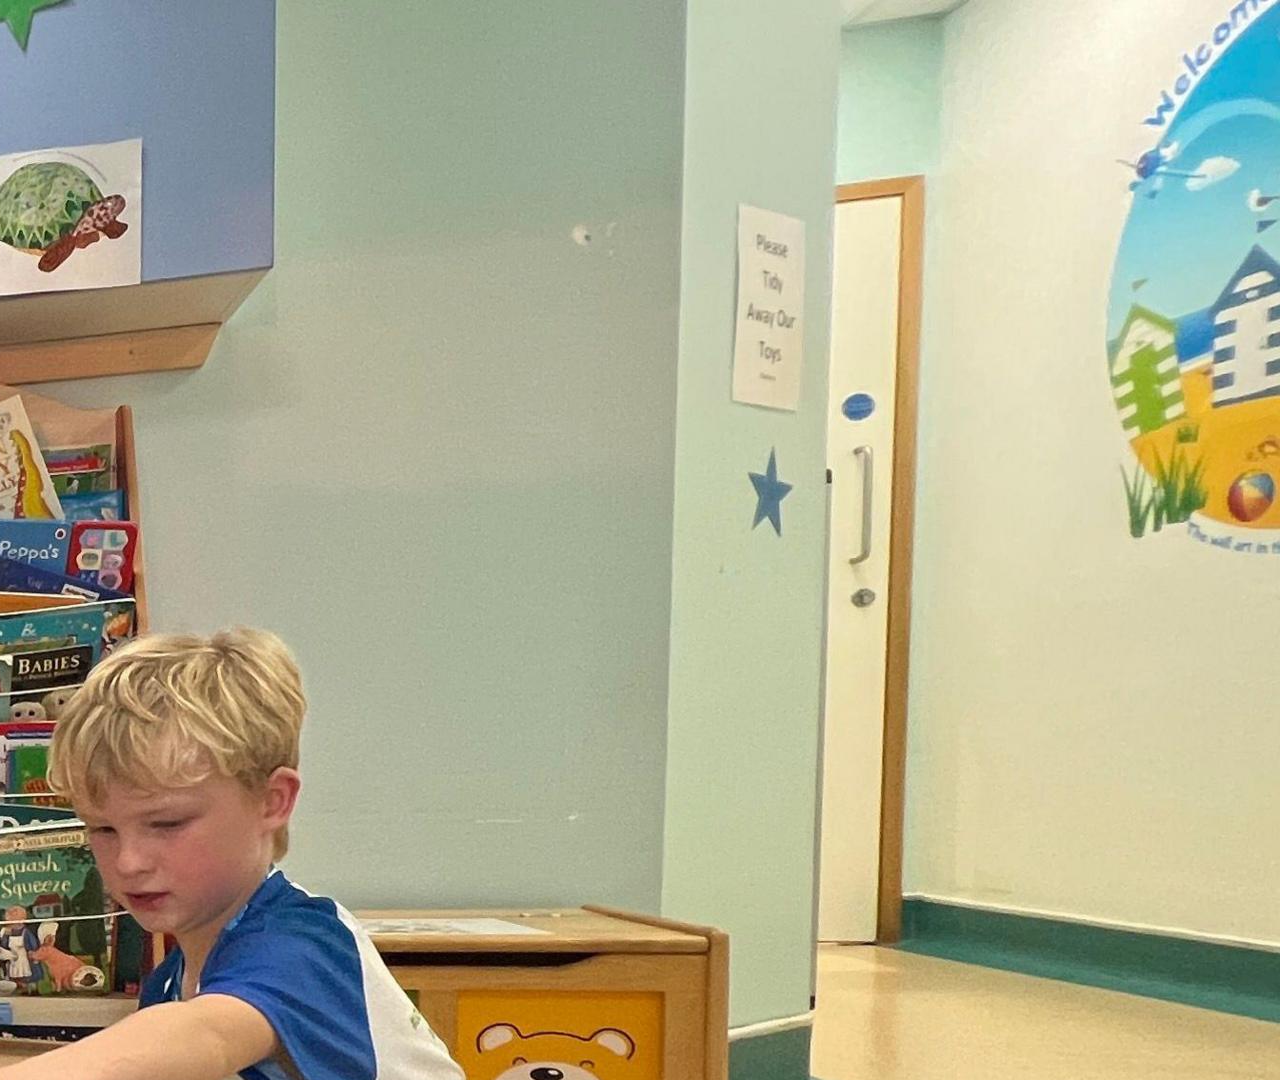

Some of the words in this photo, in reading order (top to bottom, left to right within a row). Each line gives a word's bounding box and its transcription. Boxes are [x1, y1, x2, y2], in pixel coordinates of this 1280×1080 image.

[1142, 0, 1269, 126] Welcom
[756, 233, 788, 258] Please
[762, 270, 783, 294] Tidy
[747, 303, 774, 329] Away
[777, 309, 796, 329] Our
[759, 341, 782, 365] Toys
[0, 540, 60, 563] Peppa's
[18, 654, 81, 675] BABIES
[1, 879, 72, 900] Squeeze
